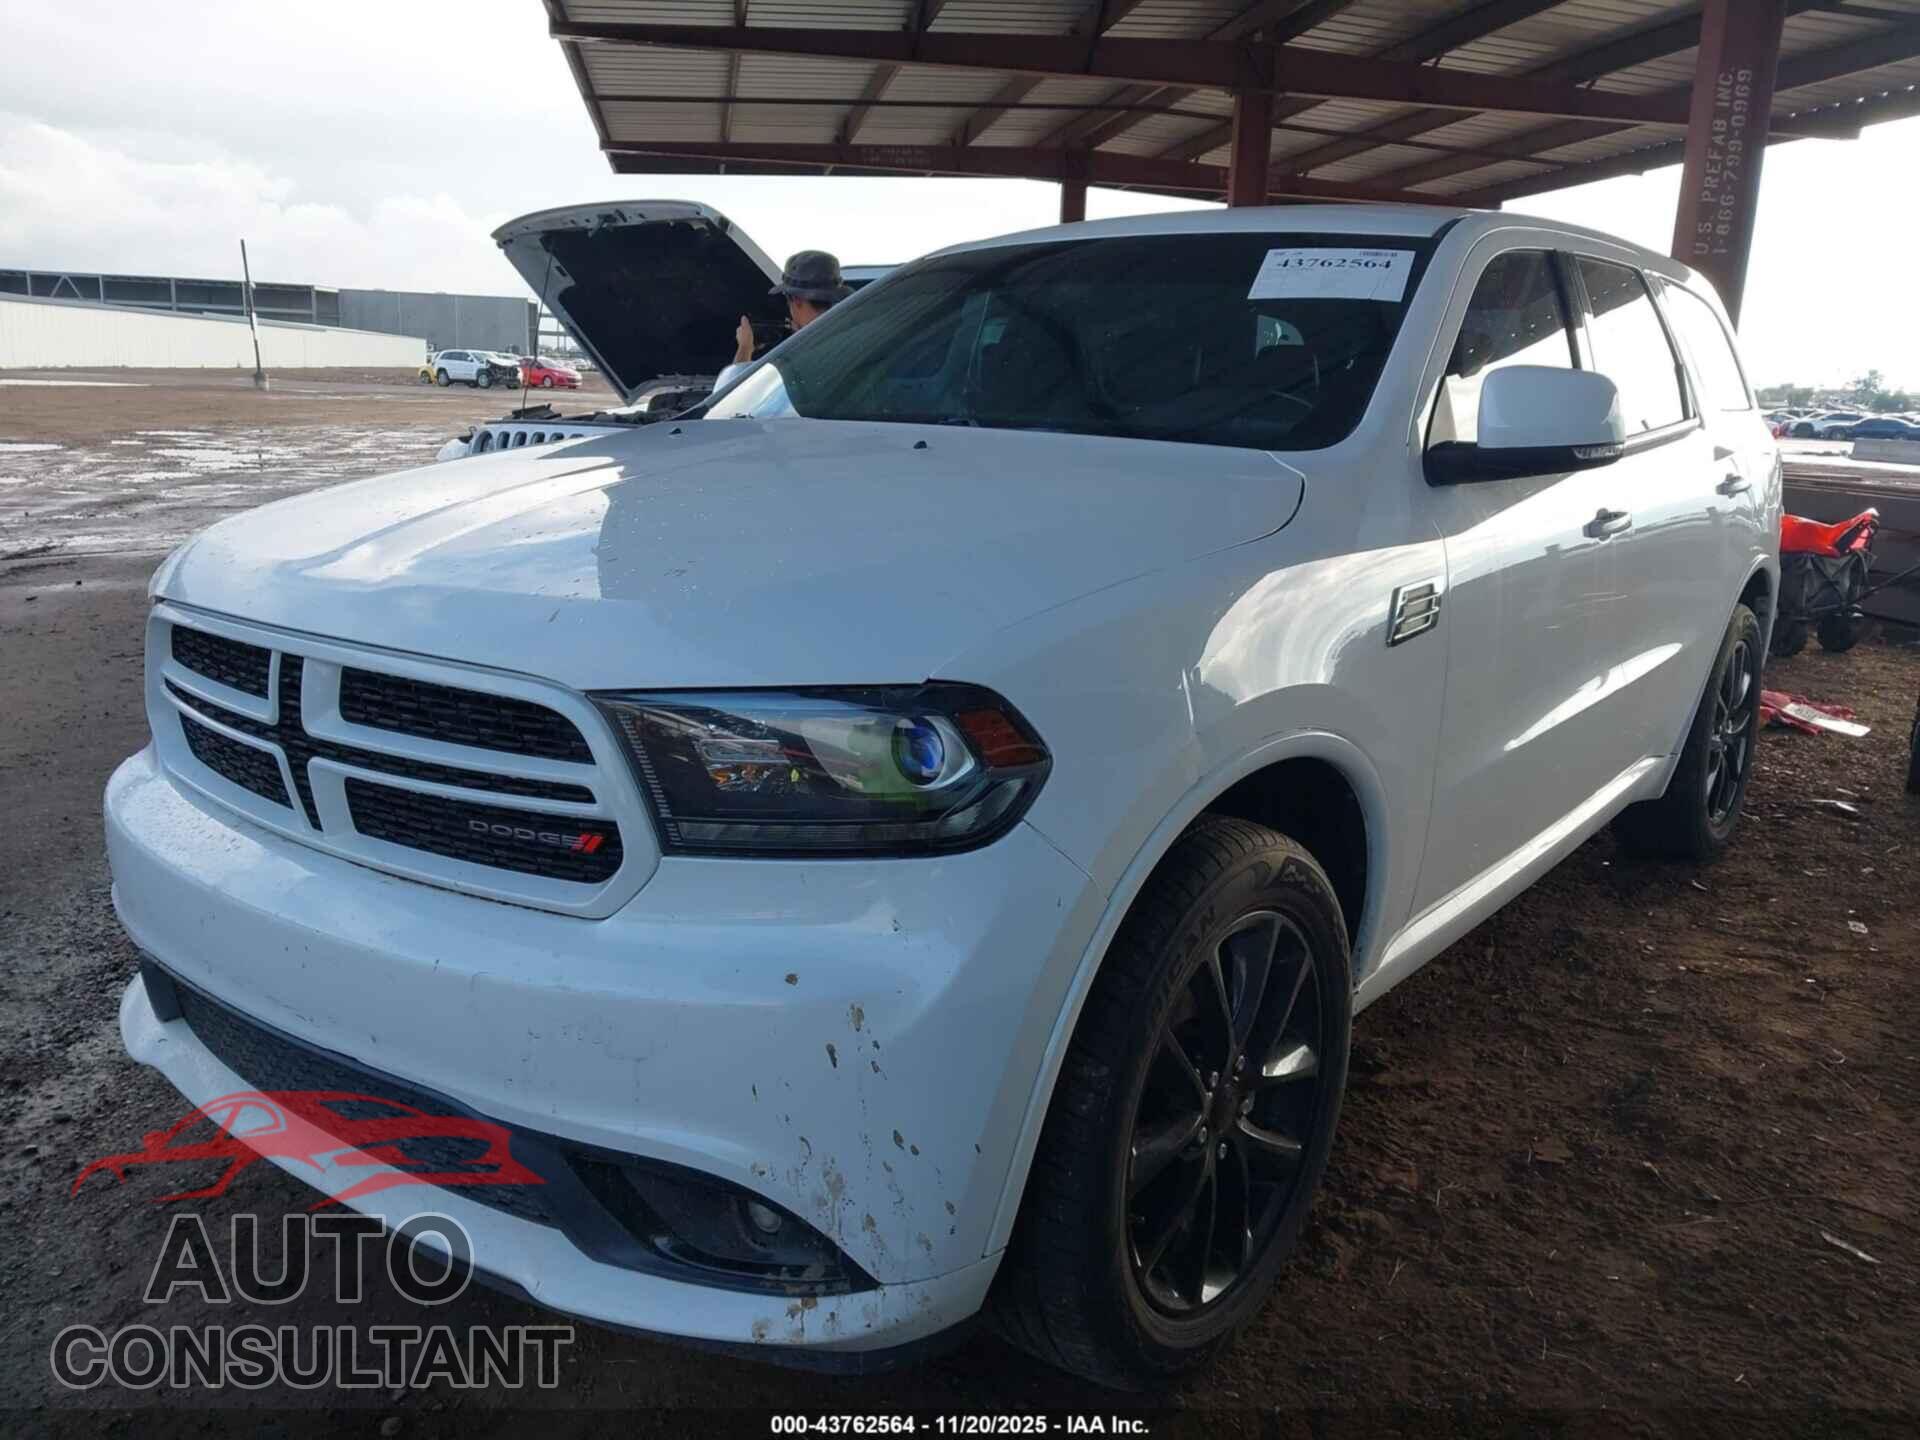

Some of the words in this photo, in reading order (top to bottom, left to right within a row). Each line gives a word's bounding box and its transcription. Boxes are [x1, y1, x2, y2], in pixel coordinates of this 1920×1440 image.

[1703, 119, 1727, 202] PREFAB
[1717, 67, 1736, 107] INC.
[1276, 257, 1393, 269] 43762564
[468, 819, 584, 848] DODGE
